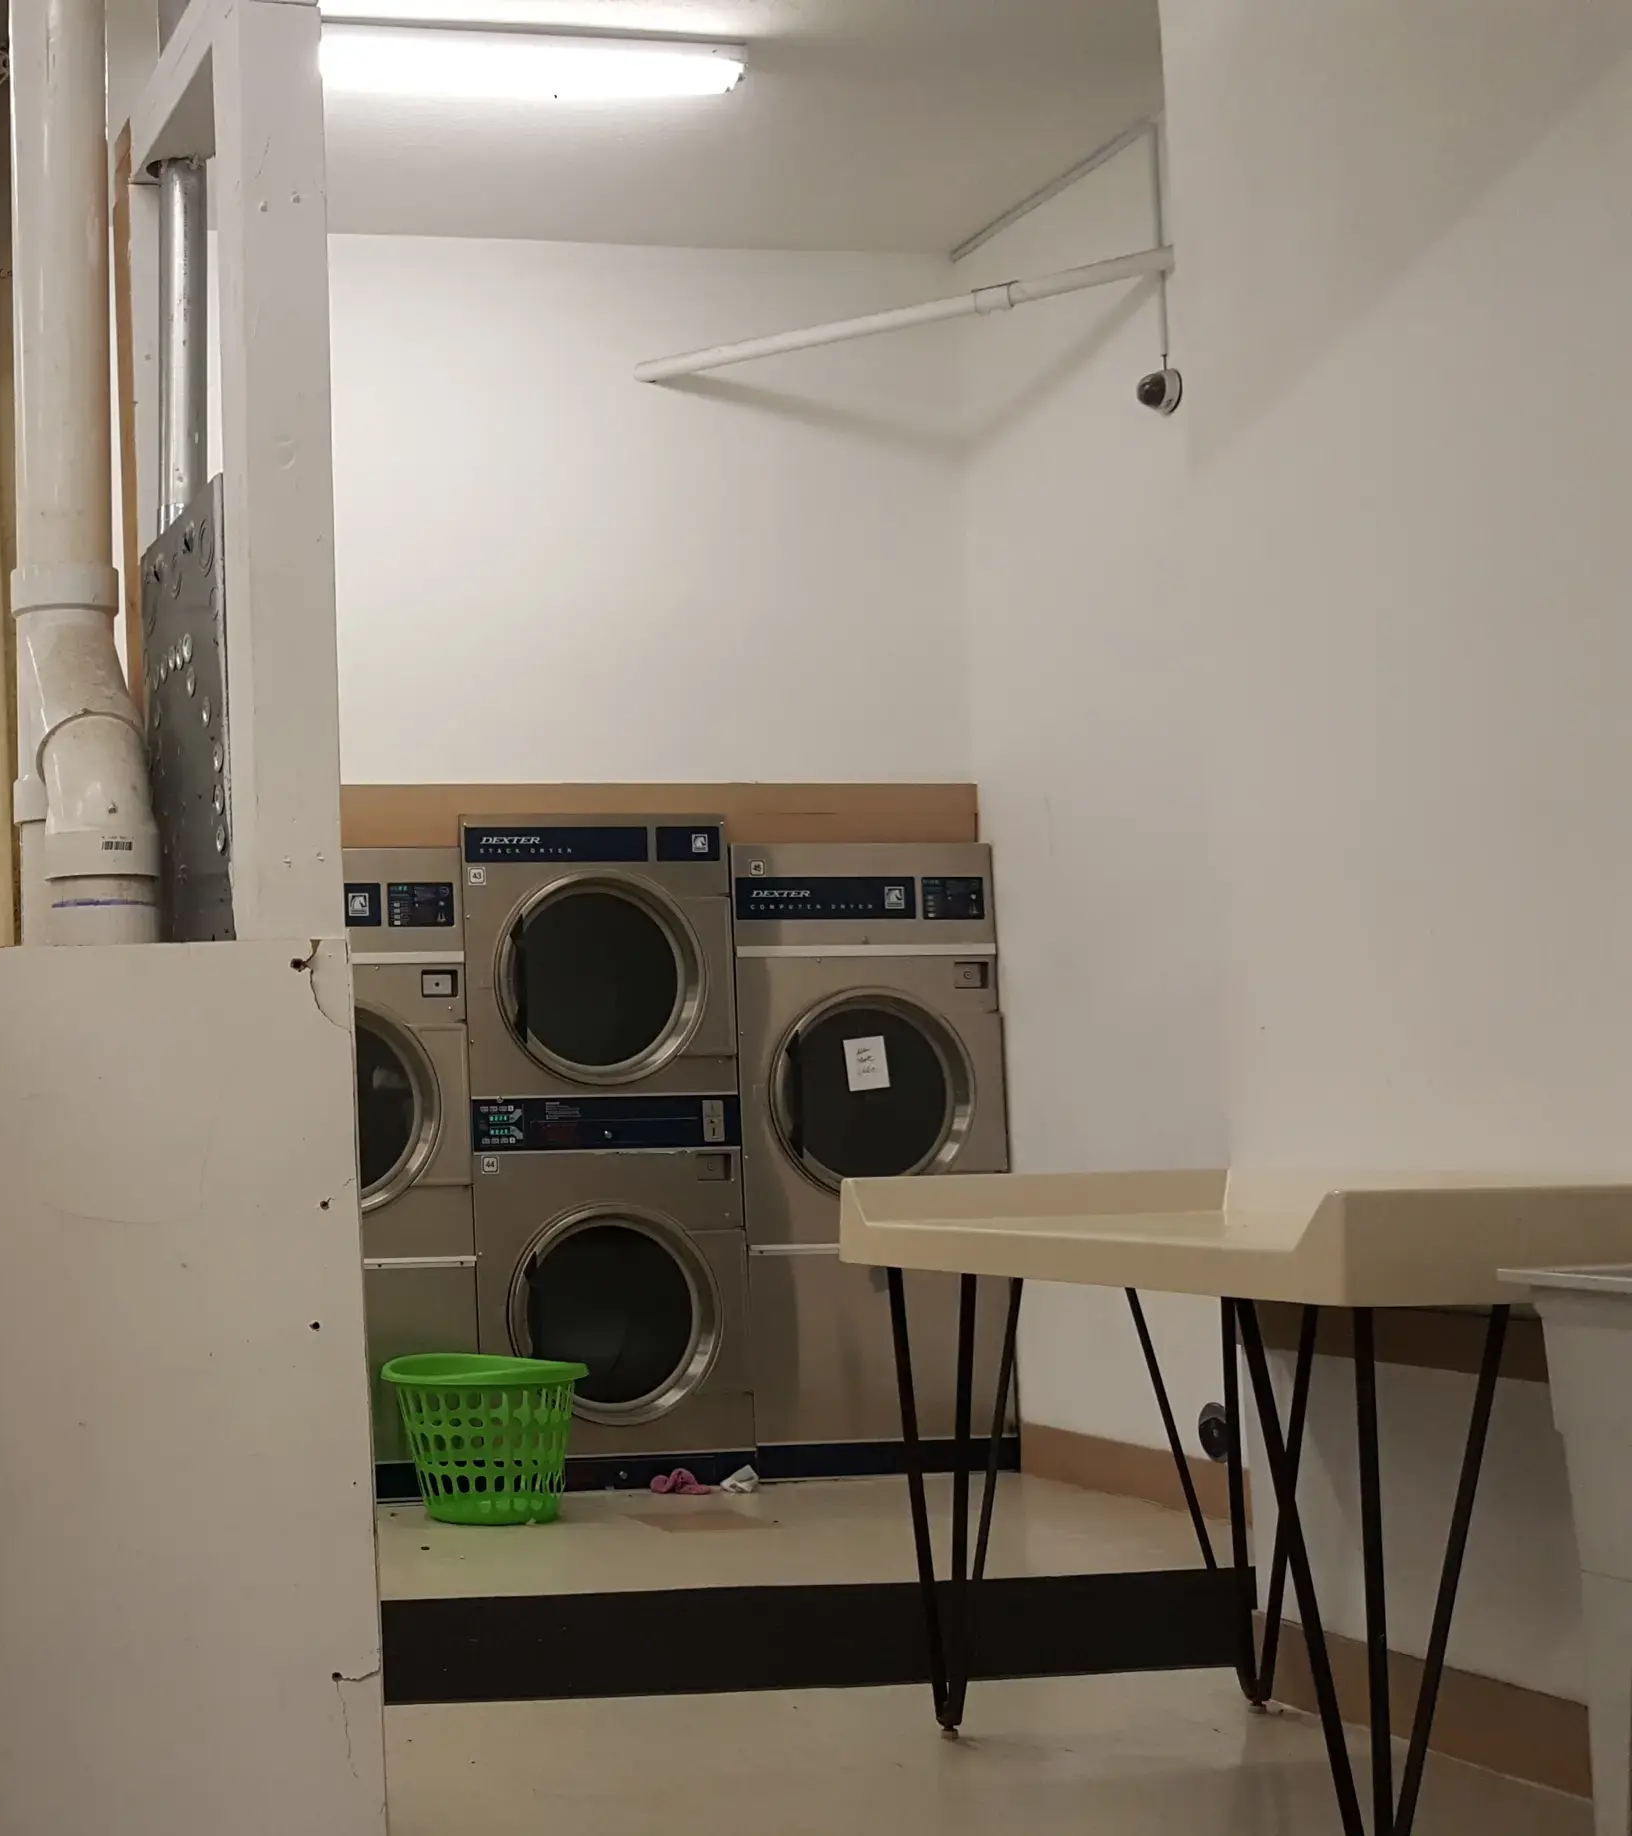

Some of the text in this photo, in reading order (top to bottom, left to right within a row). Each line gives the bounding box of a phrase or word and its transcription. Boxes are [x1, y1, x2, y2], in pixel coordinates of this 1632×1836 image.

[479, 836, 541, 845] DEXTER
[472, 872, 482, 880] 43
[751, 890, 811, 898] DEXTER
[485, 1160, 495, 1168] 44
